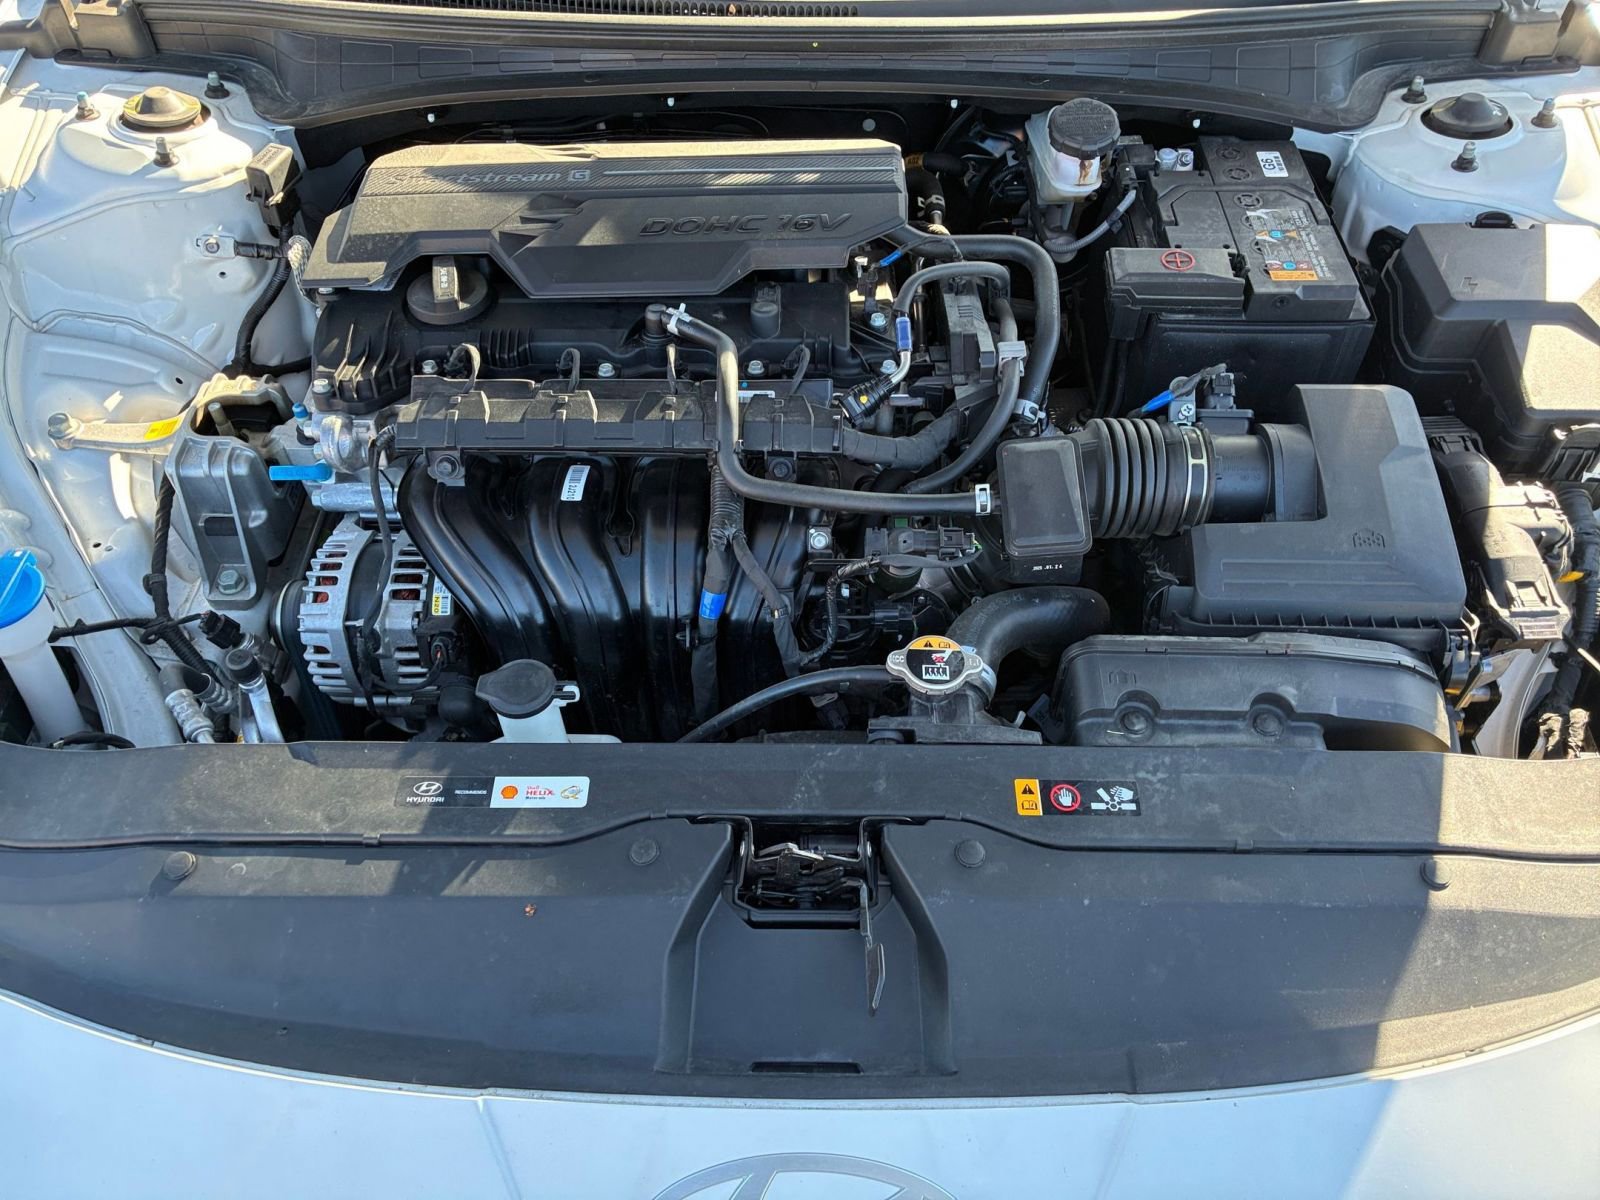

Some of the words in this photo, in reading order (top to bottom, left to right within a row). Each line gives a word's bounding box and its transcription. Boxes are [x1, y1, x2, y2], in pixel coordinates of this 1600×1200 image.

[1261, 158, 1277, 171] G6
[640, 214, 768, 236] DOHC
[777, 213, 852, 233] 16V
[406, 796, 445, 804] HYUNDAI
